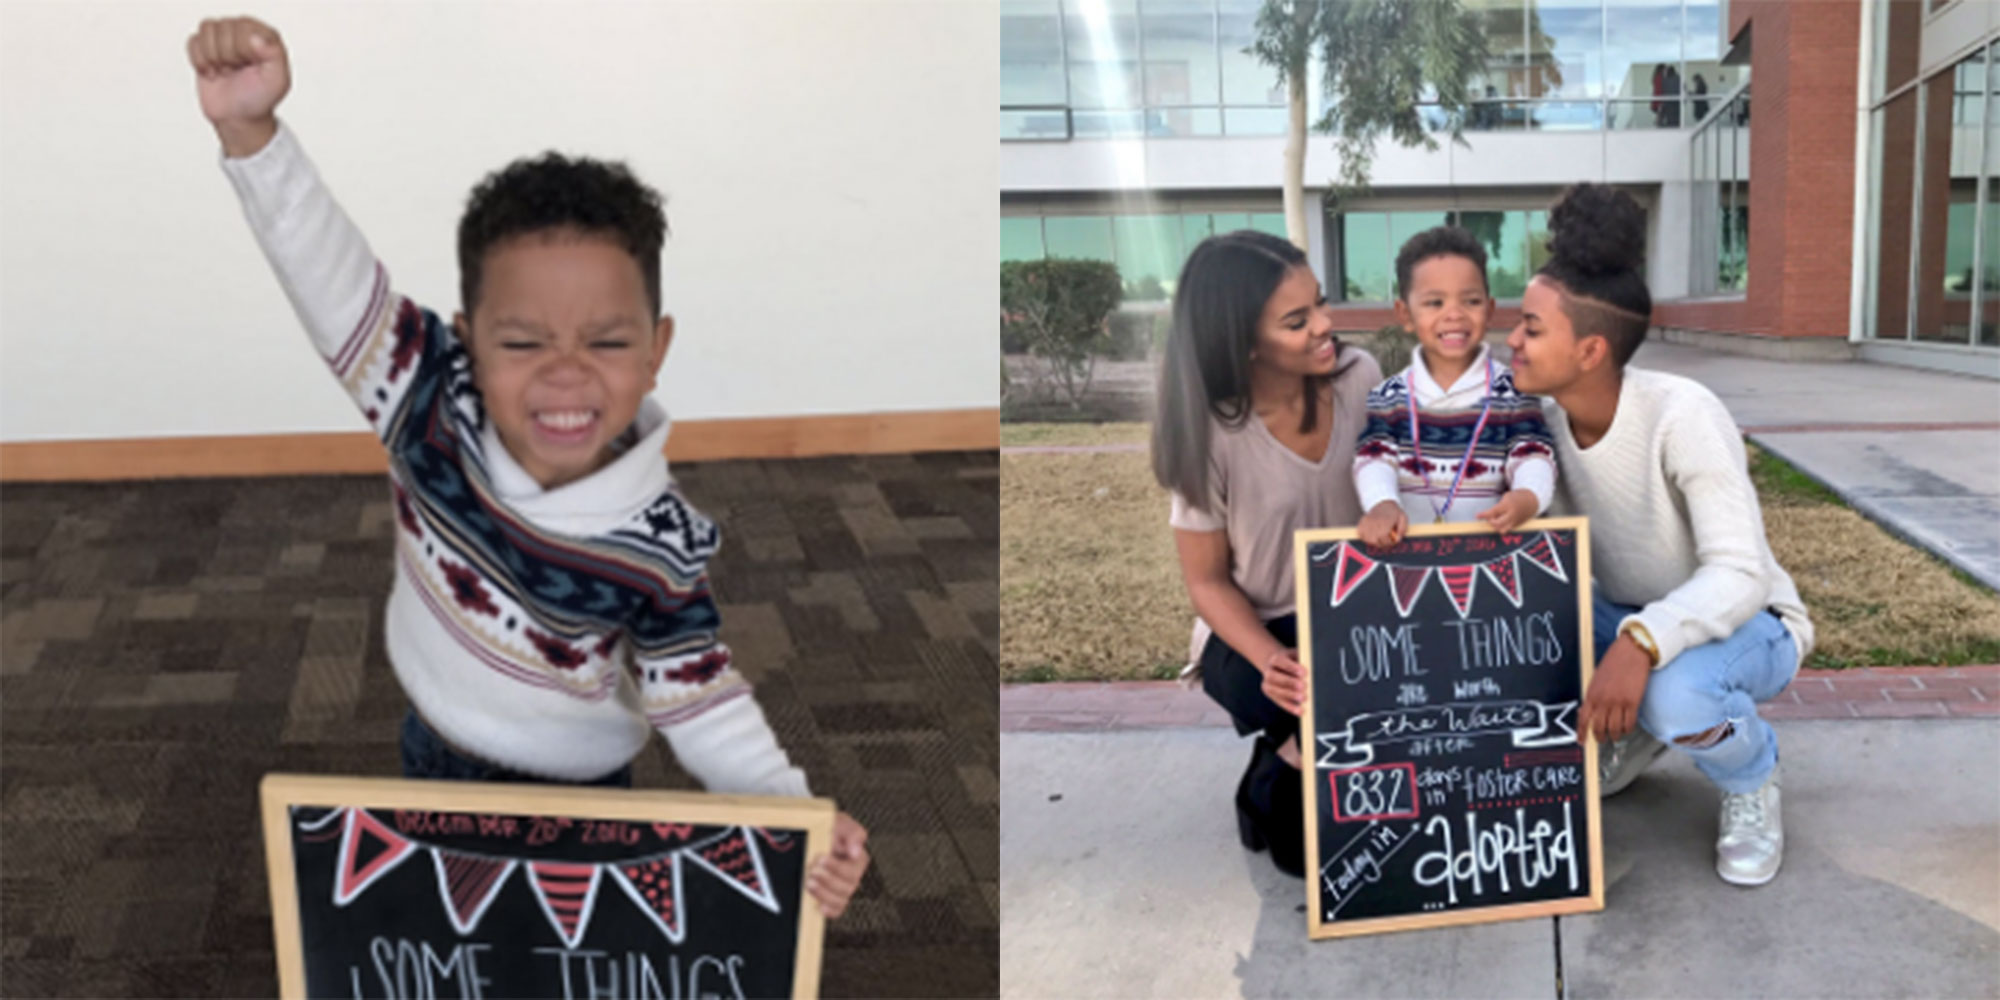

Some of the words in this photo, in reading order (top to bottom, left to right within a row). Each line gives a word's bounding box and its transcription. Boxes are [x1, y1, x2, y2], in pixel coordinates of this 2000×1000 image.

[1340, 621, 1430, 685] SOME
[1442, 610, 1563, 670] THINGS
[1366, 711, 1438, 739] the
[1345, 768, 1411, 817] 832
[1416, 765, 1463, 793] days
[1413, 800, 1580, 903] adopted
